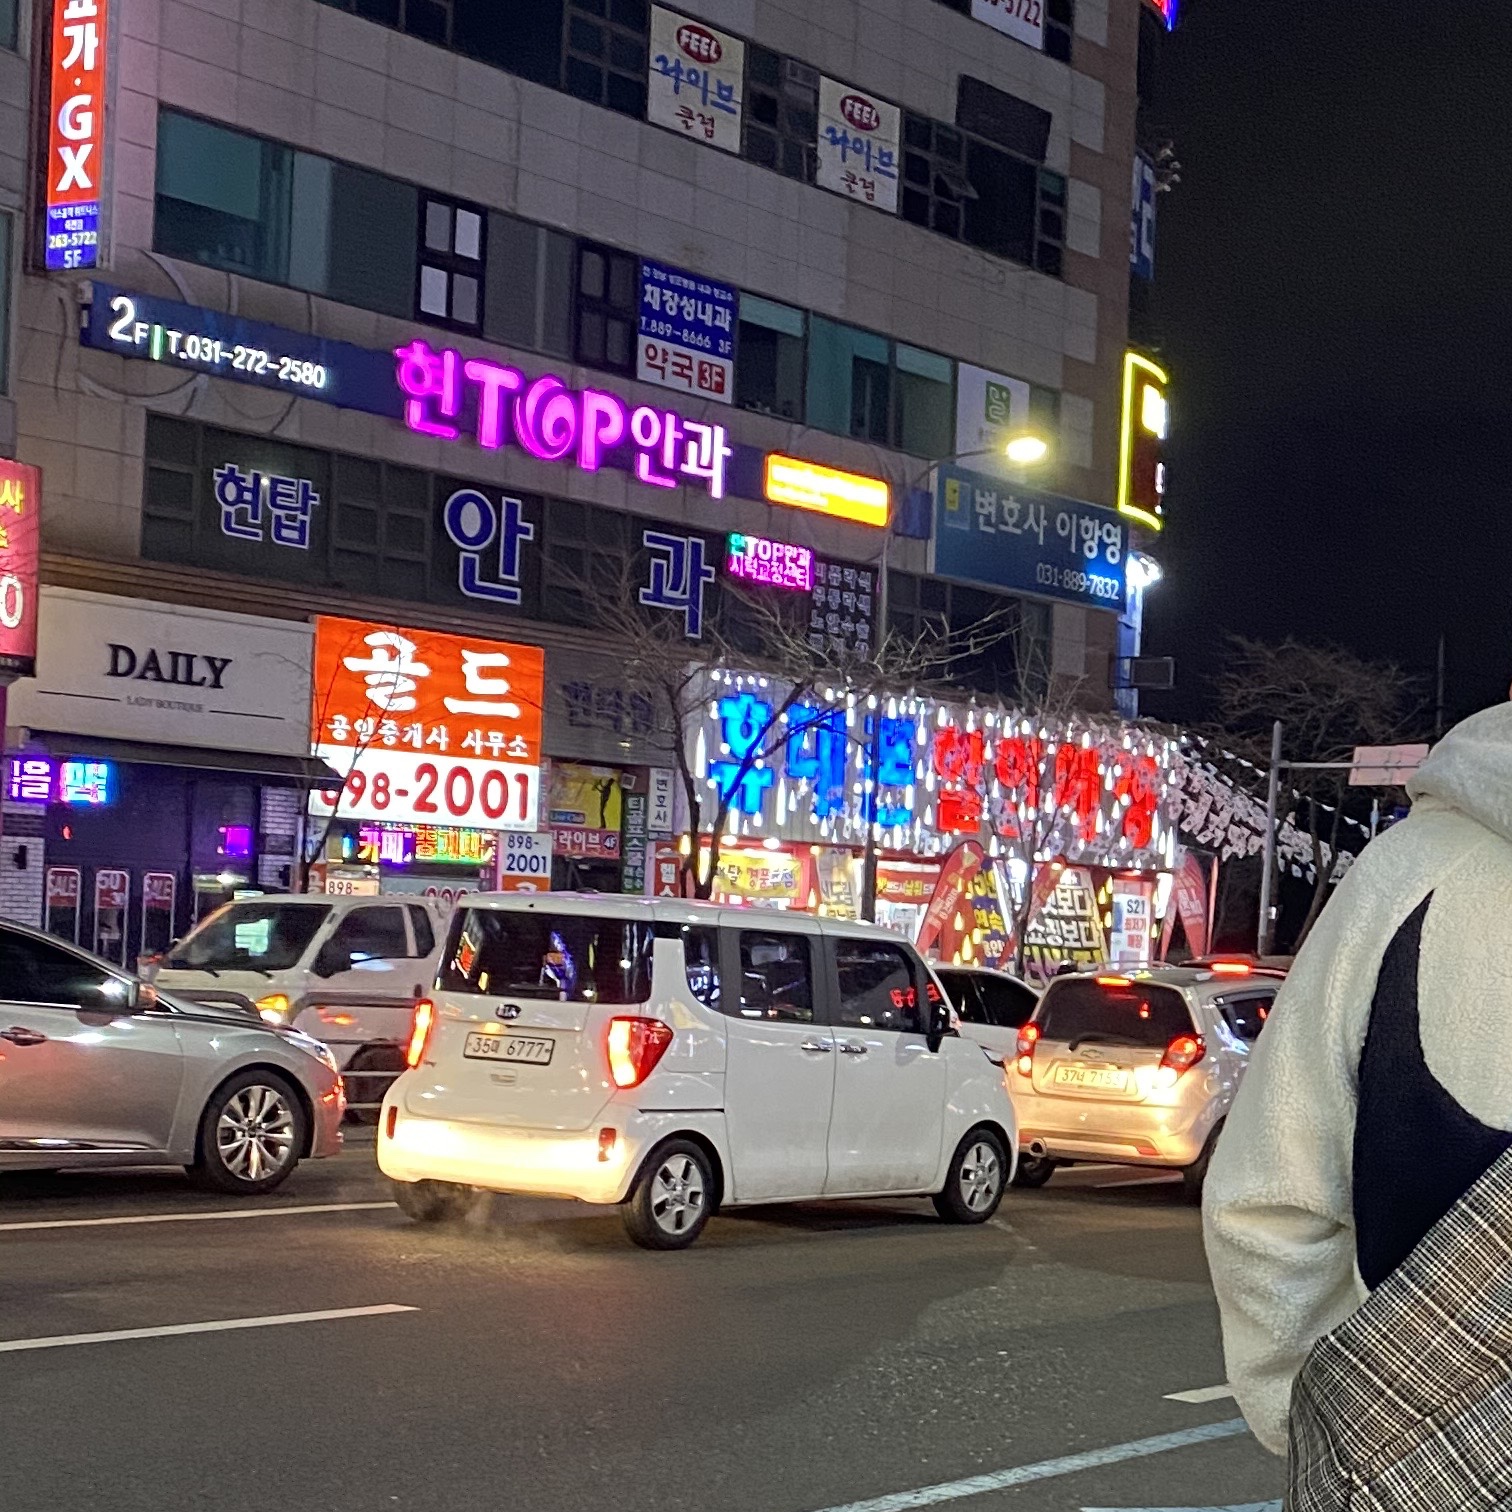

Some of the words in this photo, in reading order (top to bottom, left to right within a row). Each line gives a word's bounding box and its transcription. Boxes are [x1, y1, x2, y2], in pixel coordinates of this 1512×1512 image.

[679, 28, 719, 60] FEEL
[655, 54, 737, 115] 라이브
[676, 104, 715, 140] 클럽
[843, 98, 879, 127] FEEL
[824, 125, 897, 180] 라이브
[840, 170, 876, 200] 클럽
[63, 249, 82, 268] 5F
[166, 329, 326, 389] T.031-272-2580
[718, 339, 732, 354] 3F
[645, 343, 694, 389] 약국
[700, 363, 724, 391] 3F
[974, 488, 1049, 546] 변호사
[1055, 512, 1122, 565] 이항영
[212, 463, 320, 550] 현탑
[444, 488, 534, 605] 안
[638, 530, 716, 640] 과
[104, 643, 233, 689] DAILY
[343, 631, 521, 719] 골드
[327, 714, 449, 752] 공인중개사
[460, 728, 530, 758] 사무소
[506, 834, 540, 850] 898-
[506, 853, 547, 873] 2001
[327, 880, 359, 896] 898-
[1126, 899, 1146, 914] S21
[507, 1040, 545, 1058] 6777
